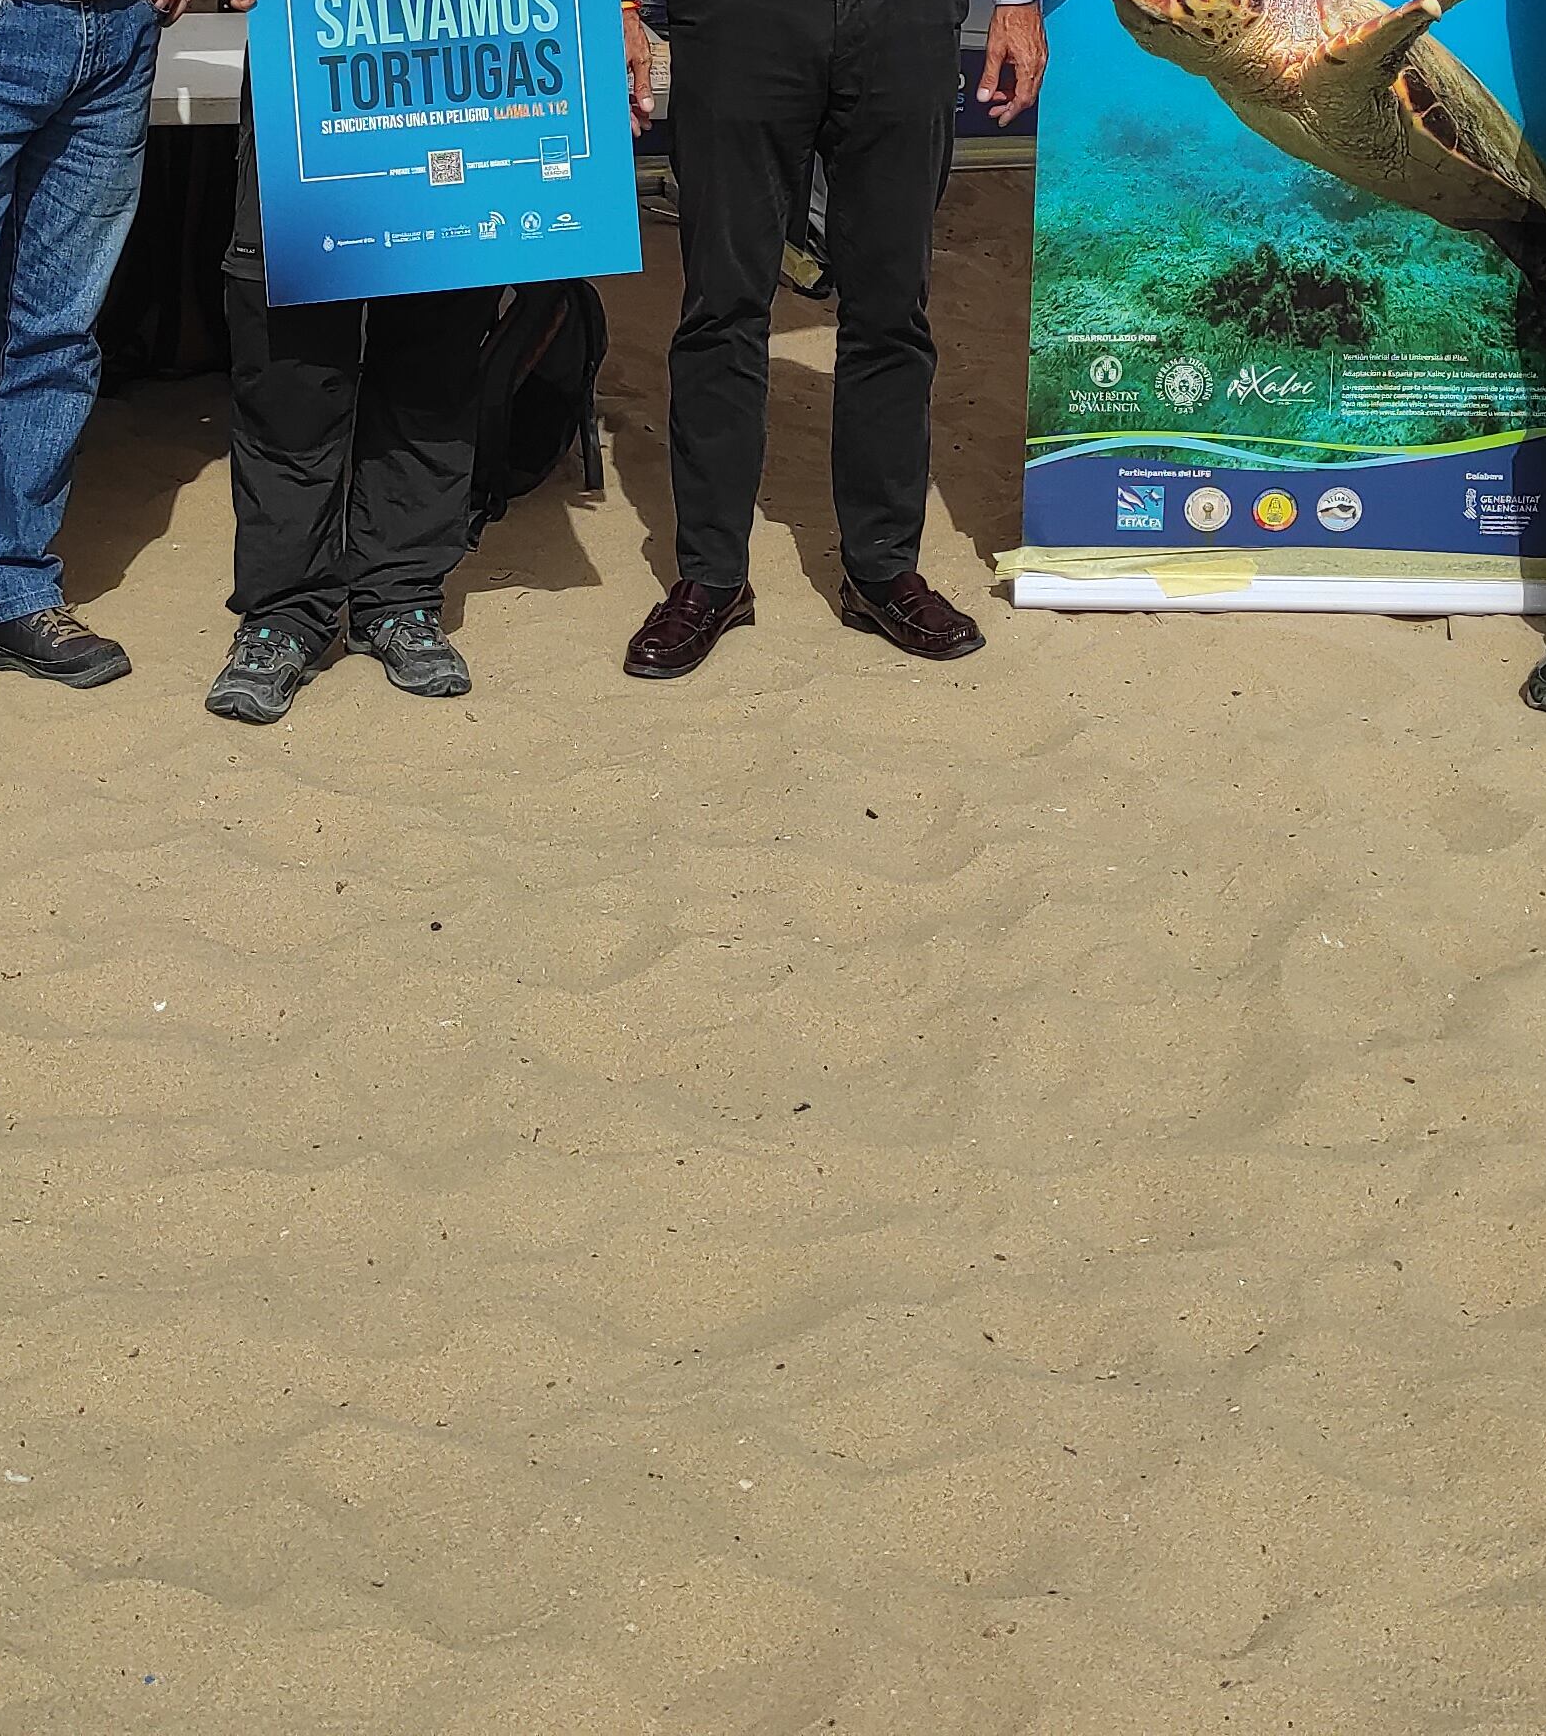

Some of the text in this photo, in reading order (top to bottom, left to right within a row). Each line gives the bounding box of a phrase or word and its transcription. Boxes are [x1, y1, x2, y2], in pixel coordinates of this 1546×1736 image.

[318, 38, 564, 113] TORTUGAS
[321, 107, 494, 135] SI ENCUENTRAS UNA EN PELIGRO,
[1479, 494, 1541, 505] GENERALITAT
[1480, 504, 1539, 513] VALENCIANA
